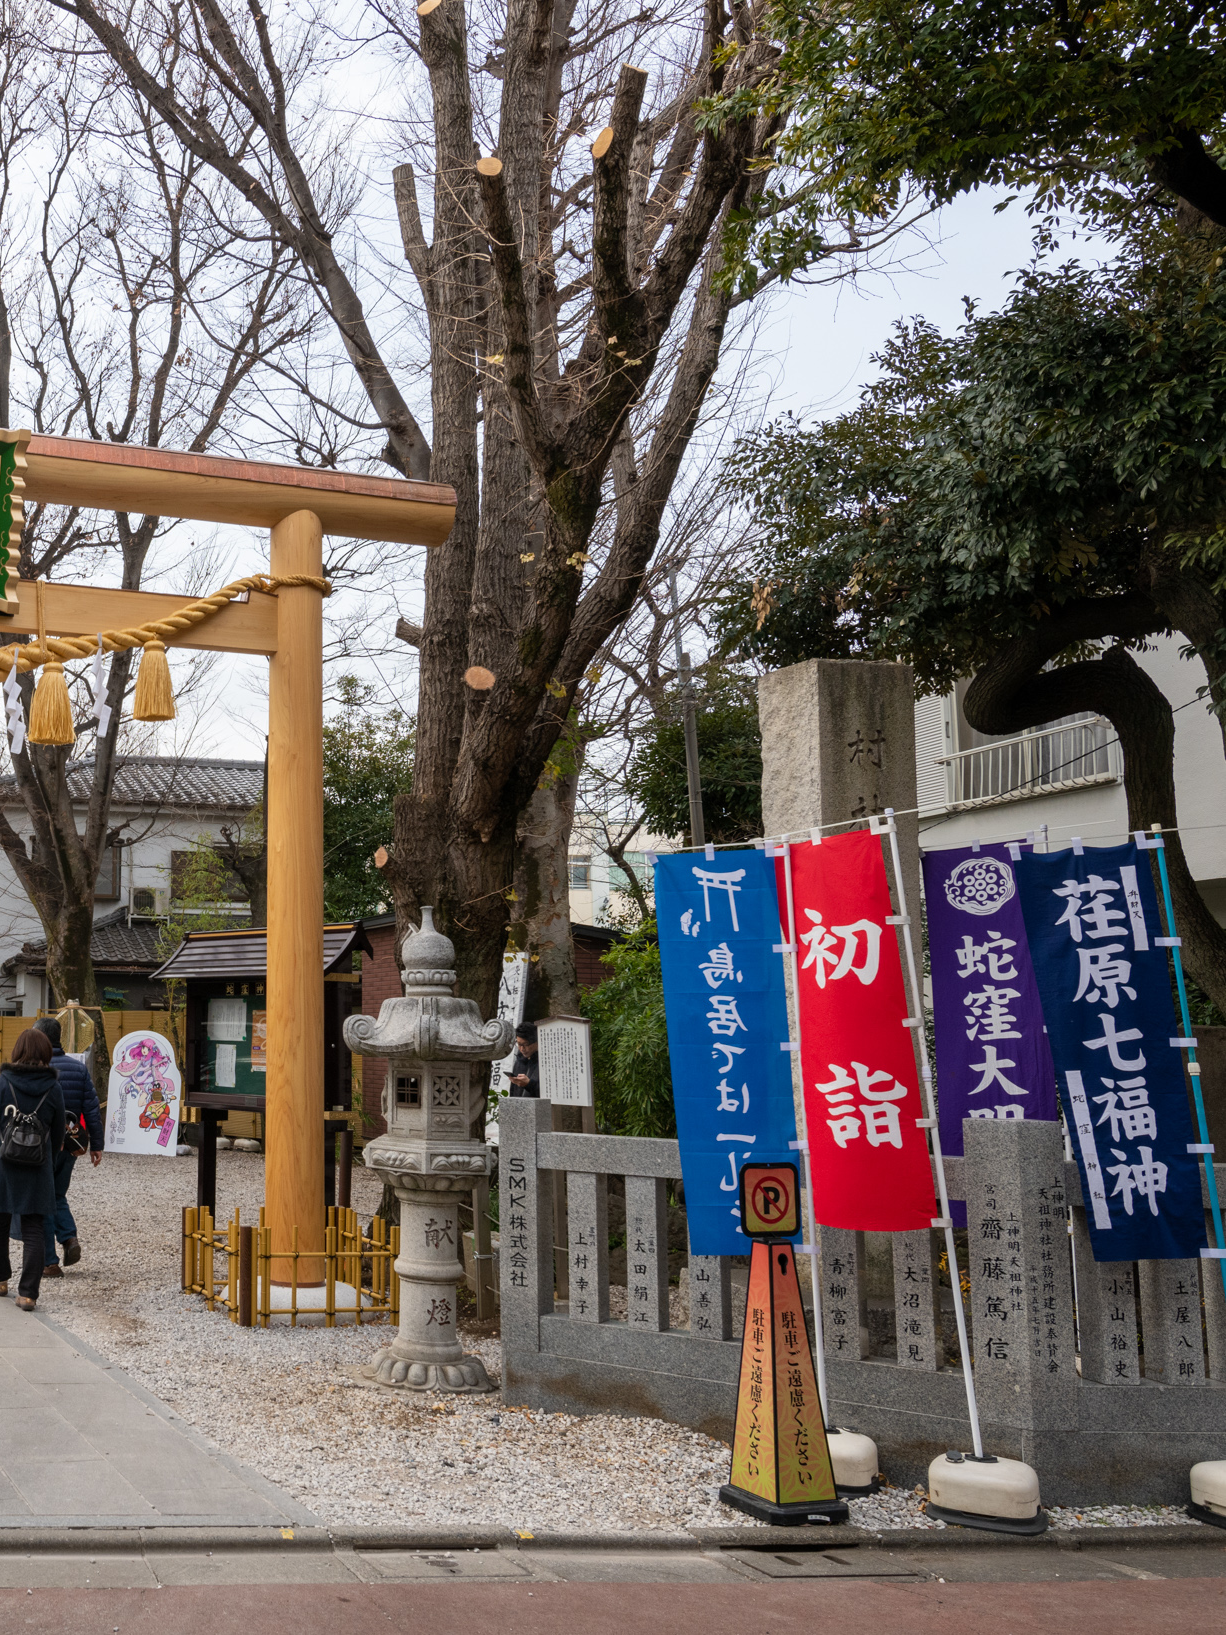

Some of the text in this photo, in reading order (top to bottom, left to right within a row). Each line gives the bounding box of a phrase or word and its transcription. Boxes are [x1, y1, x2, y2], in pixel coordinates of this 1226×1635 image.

[799, 908, 908, 1149] 初詣
[1052, 874, 1169, 1217] 荏原七福神
[984, 1184, 997, 1211] 宮司
[1072, 1094, 1103, 1201] 蛇窪神社
[509, 1158, 529, 1288] SMK株式会社
[1051, 1177, 1065, 1220] 上神明
[424, 1218, 455, 1327] 献燈
[574, 1232, 589, 1315] 上村幸子
[634, 1239, 649, 1323] 太田絹江
[829, 1258, 849, 1350] 青柳富子
[1006, 1212, 1024, 1312] 上神明天祖神社
[1038, 1188, 1060, 1374] 天祖神社社務所建設奉賛会
[903, 1266, 924, 1362] 大沼滝見
[1108, 1279, 1130, 1378] 小山裕史
[1174, 1281, 1195, 1378] 土屋八郎
[748, 1307, 765, 1477] 駐車ご遠慮ください
[781, 1311, 812, 1485] 駐車ご遠慮ください
